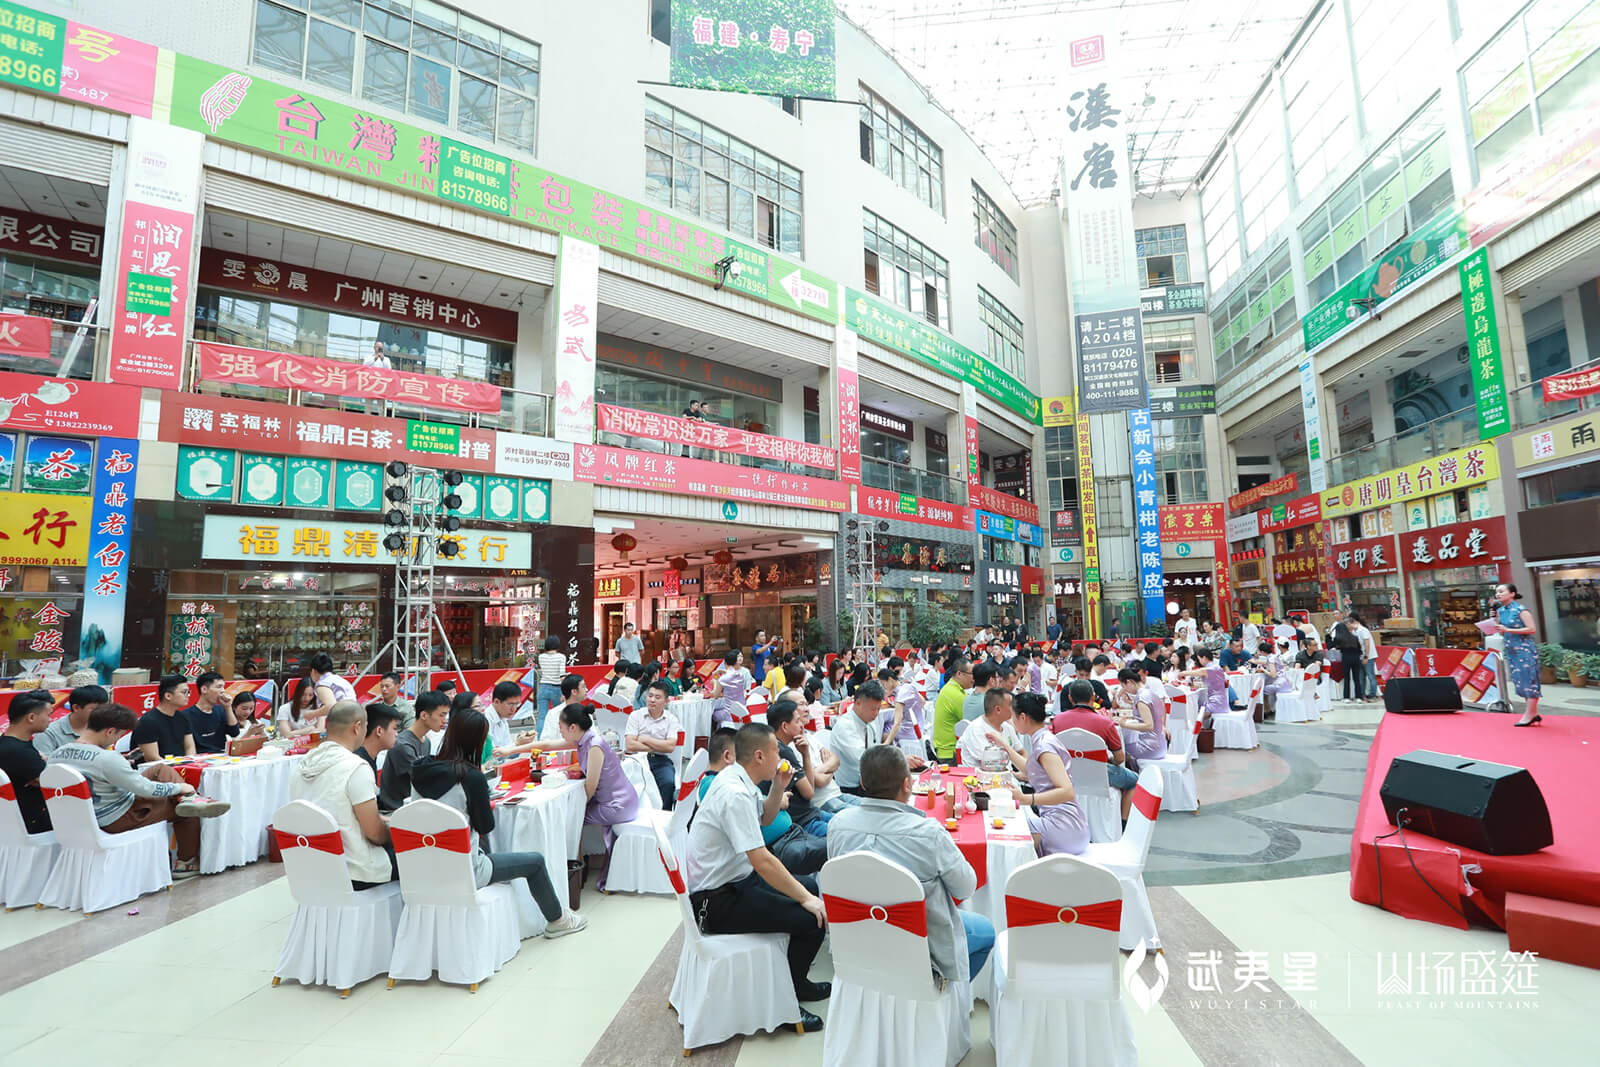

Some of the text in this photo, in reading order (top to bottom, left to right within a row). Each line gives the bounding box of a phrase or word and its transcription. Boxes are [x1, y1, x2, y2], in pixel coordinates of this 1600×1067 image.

[69, 27, 120, 62] 号
[693, 17, 815, 55] 福建·寿宁
[274, 134, 382, 178] TAIWAN
[447, 145, 507, 176] 广告位招商
[453, 164, 500, 189] 咨询电话:
[441, 179, 508, 212] 81578966
[524, 208, 621, 248] PACKAGE
[333, 281, 482, 330] 广州营销中心
[1080, 316, 1136, 333] 请上二楼
[1081, 329, 1137, 346] A204档
[216, 352, 471, 407] 强化消防宣传
[1083, 358, 1139, 374] 81179476
[219, 412, 282, 432] 宝福林
[412, 423, 455, 436] 广告位招商
[605, 406, 836, 468] 消防常识进万家 平安相伴你我他
[1570, 421, 1596, 449] 雨
[38, 447, 80, 481] 茶
[521, 456, 535, 465] 159
[604, 451, 678, 475] 凤牌红茶
[1358, 449, 1486, 508] 唐明皇台灣茶
[1131, 409, 1163, 589] 古新会小青柑老陈皮
[22, 507, 77, 550] 行
[92, 448, 134, 597] 福鼎老白茶
[52, 557, 78, 567] A114
[1336, 544, 1388, 570] 好印象
[239, 577, 320, 592] 厂家直销
[181, 602, 216, 615] 浙江
[566, 582, 581, 667] 福鼎老白茶
